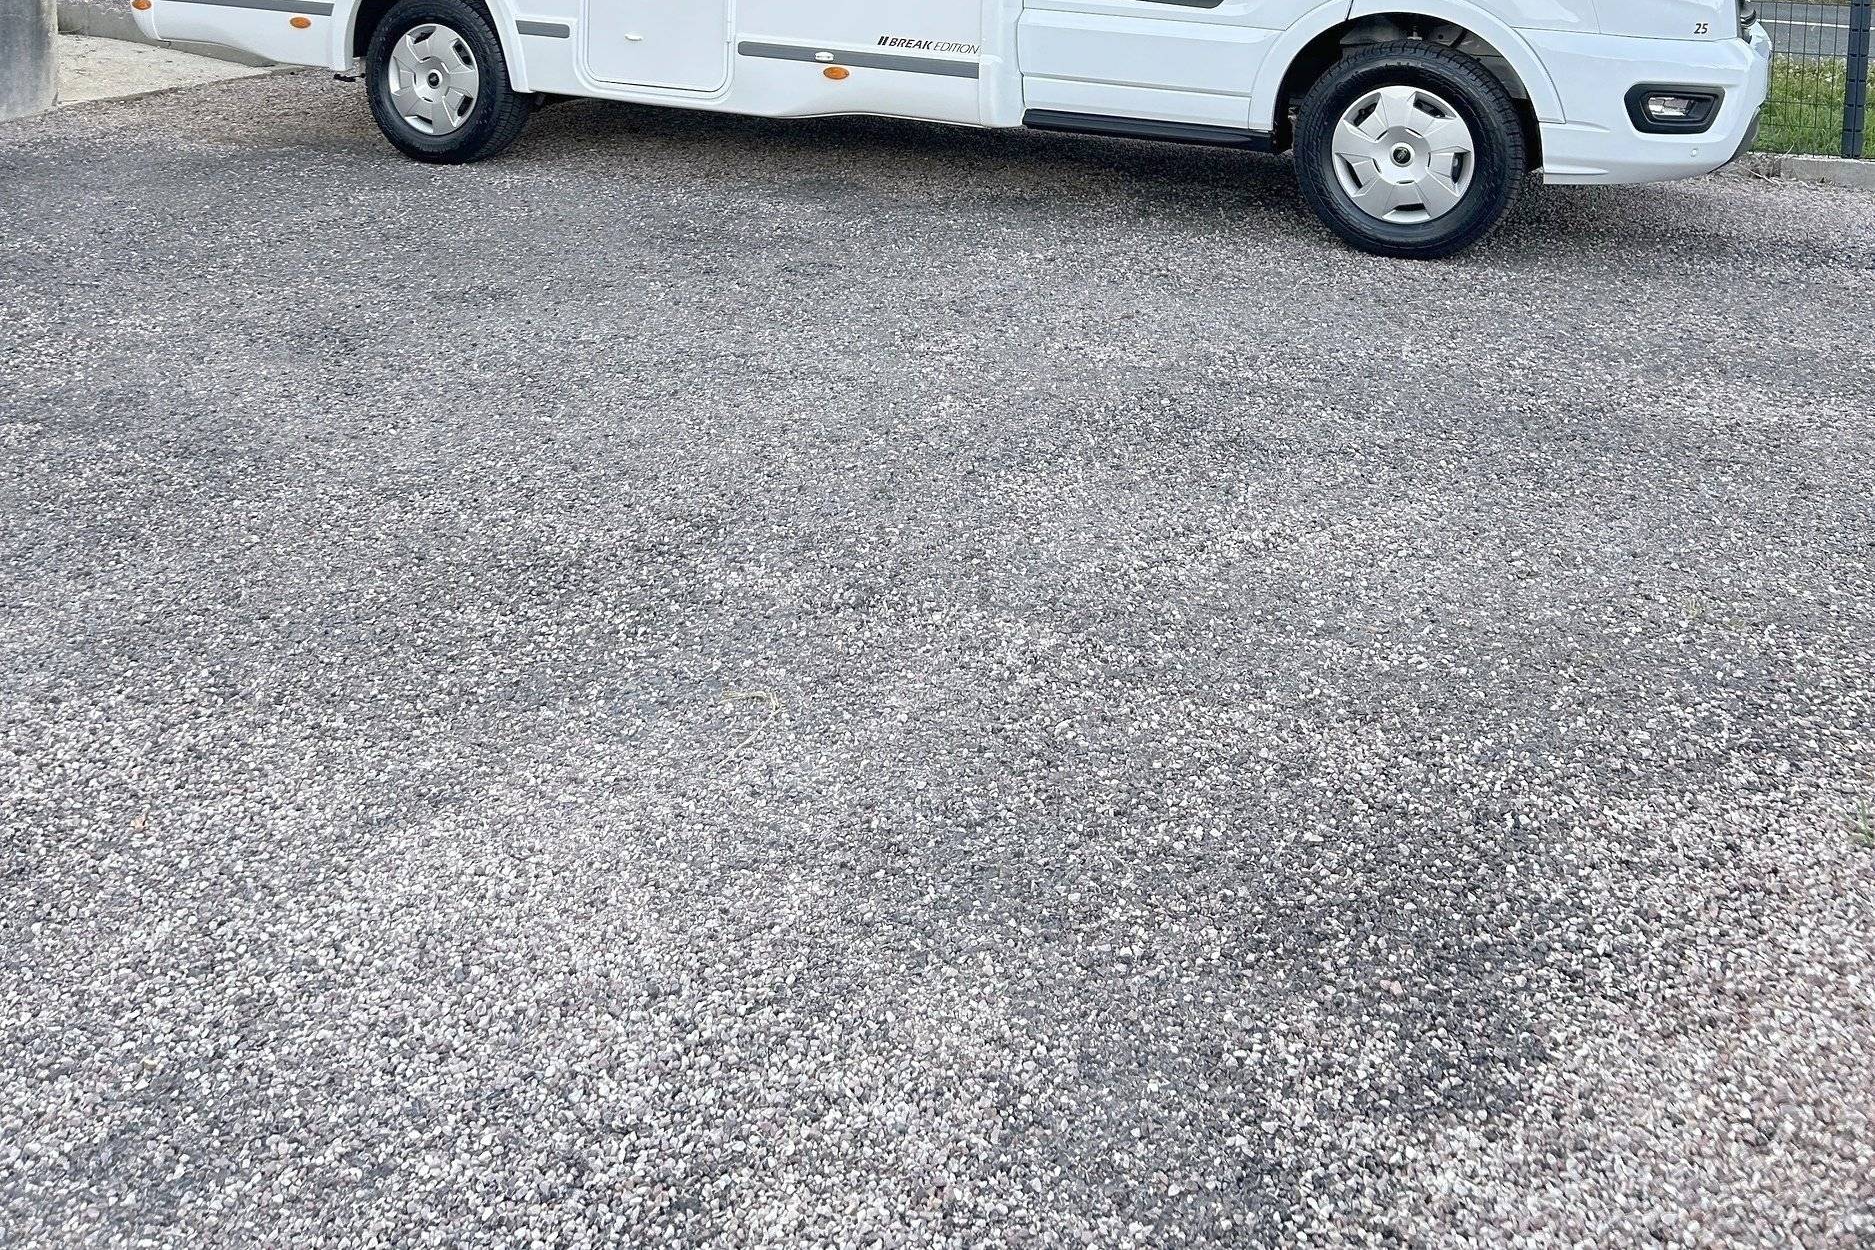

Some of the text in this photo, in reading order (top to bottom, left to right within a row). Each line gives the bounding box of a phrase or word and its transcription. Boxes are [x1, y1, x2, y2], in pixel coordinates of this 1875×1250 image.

[1694, 23, 1708, 34] 25
[889, 38, 979, 54] BREAK EDITION
